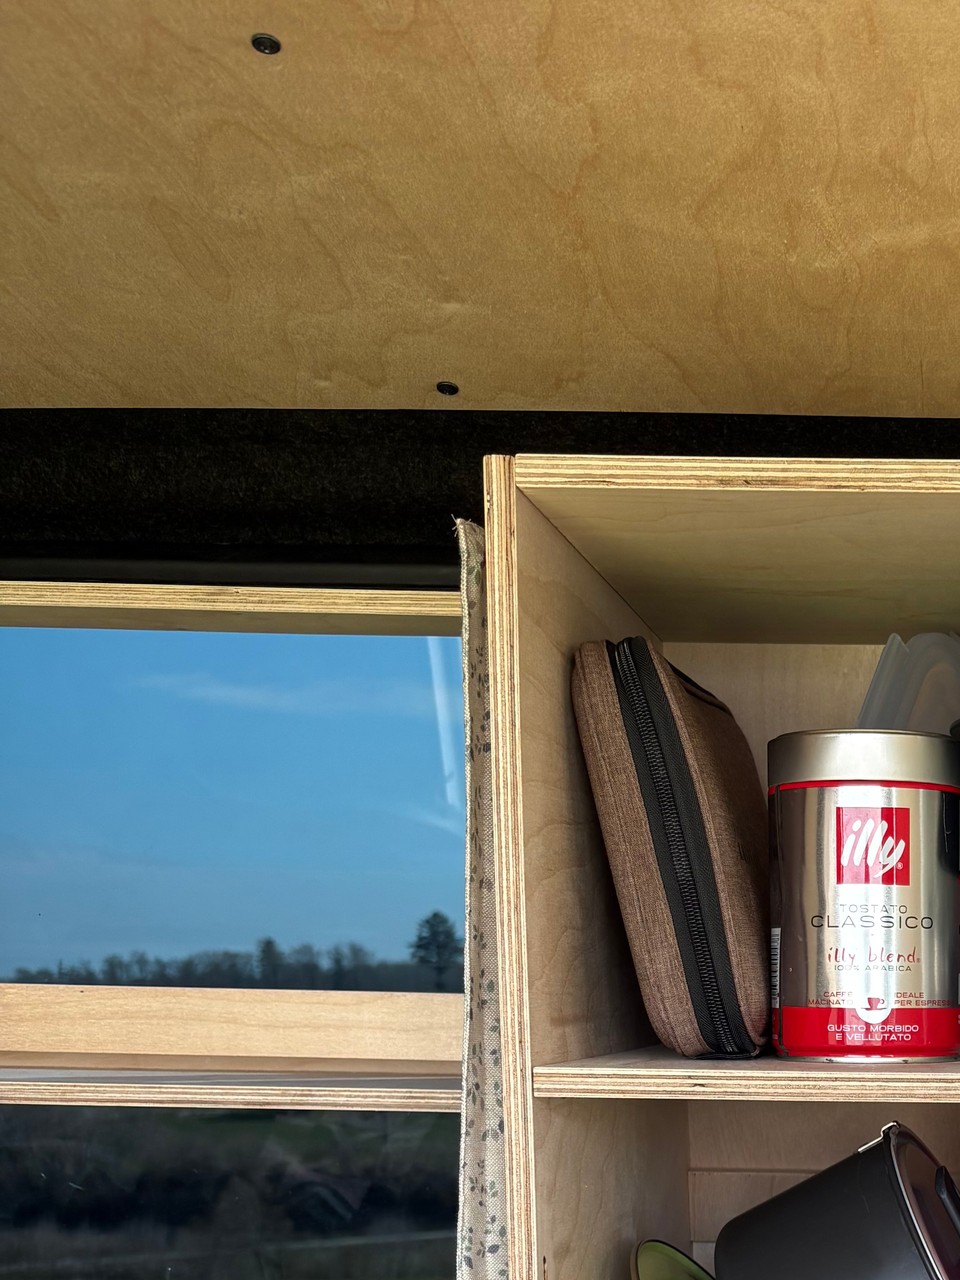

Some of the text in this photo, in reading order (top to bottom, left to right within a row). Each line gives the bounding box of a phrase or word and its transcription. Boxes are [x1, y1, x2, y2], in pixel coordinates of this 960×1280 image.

[841, 818, 906, 878] illy
[840, 904, 908, 914] TOSTATO
[810, 915, 934, 930] CLASSICO
[827, 946, 917, 965] illy blend
[894, 991, 925, 999] IDEALE
[808, 998, 854, 1006] MACINATO
[894, 999, 913, 1007] PER
[827, 1024, 920, 1033] GUSTO MORBIDO
[835, 1033, 912, 1042] E VELLUTATO
